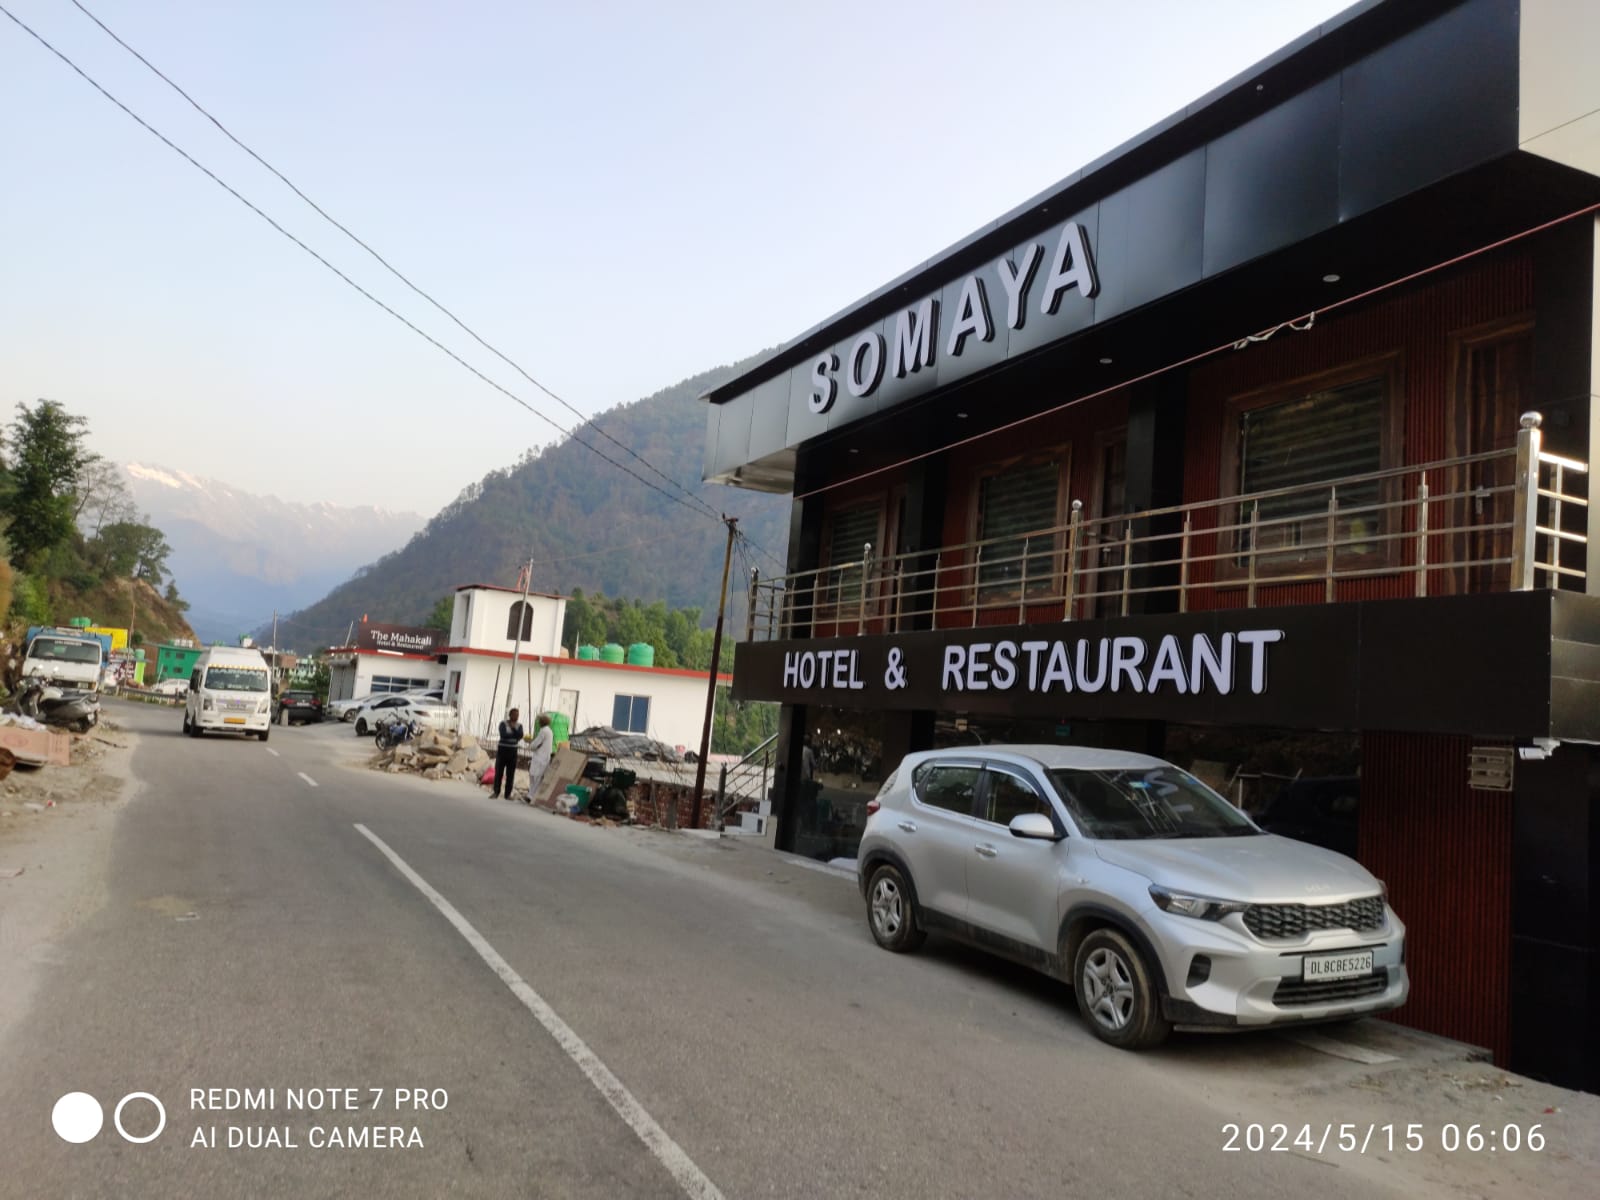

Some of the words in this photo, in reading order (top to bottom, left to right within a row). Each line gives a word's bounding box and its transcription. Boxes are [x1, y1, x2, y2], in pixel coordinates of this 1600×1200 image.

[808, 221, 1099, 415] SOMAYA
[371, 630, 389, 641] The
[391, 632, 432, 646] Mahakali
[783, 649, 864, 689] HOTEL
[884, 647, 907, 690] &
[942, 629, 1284, 695] RESTAURANT
[1310, 956, 1371, 975] DL8CBE5226
